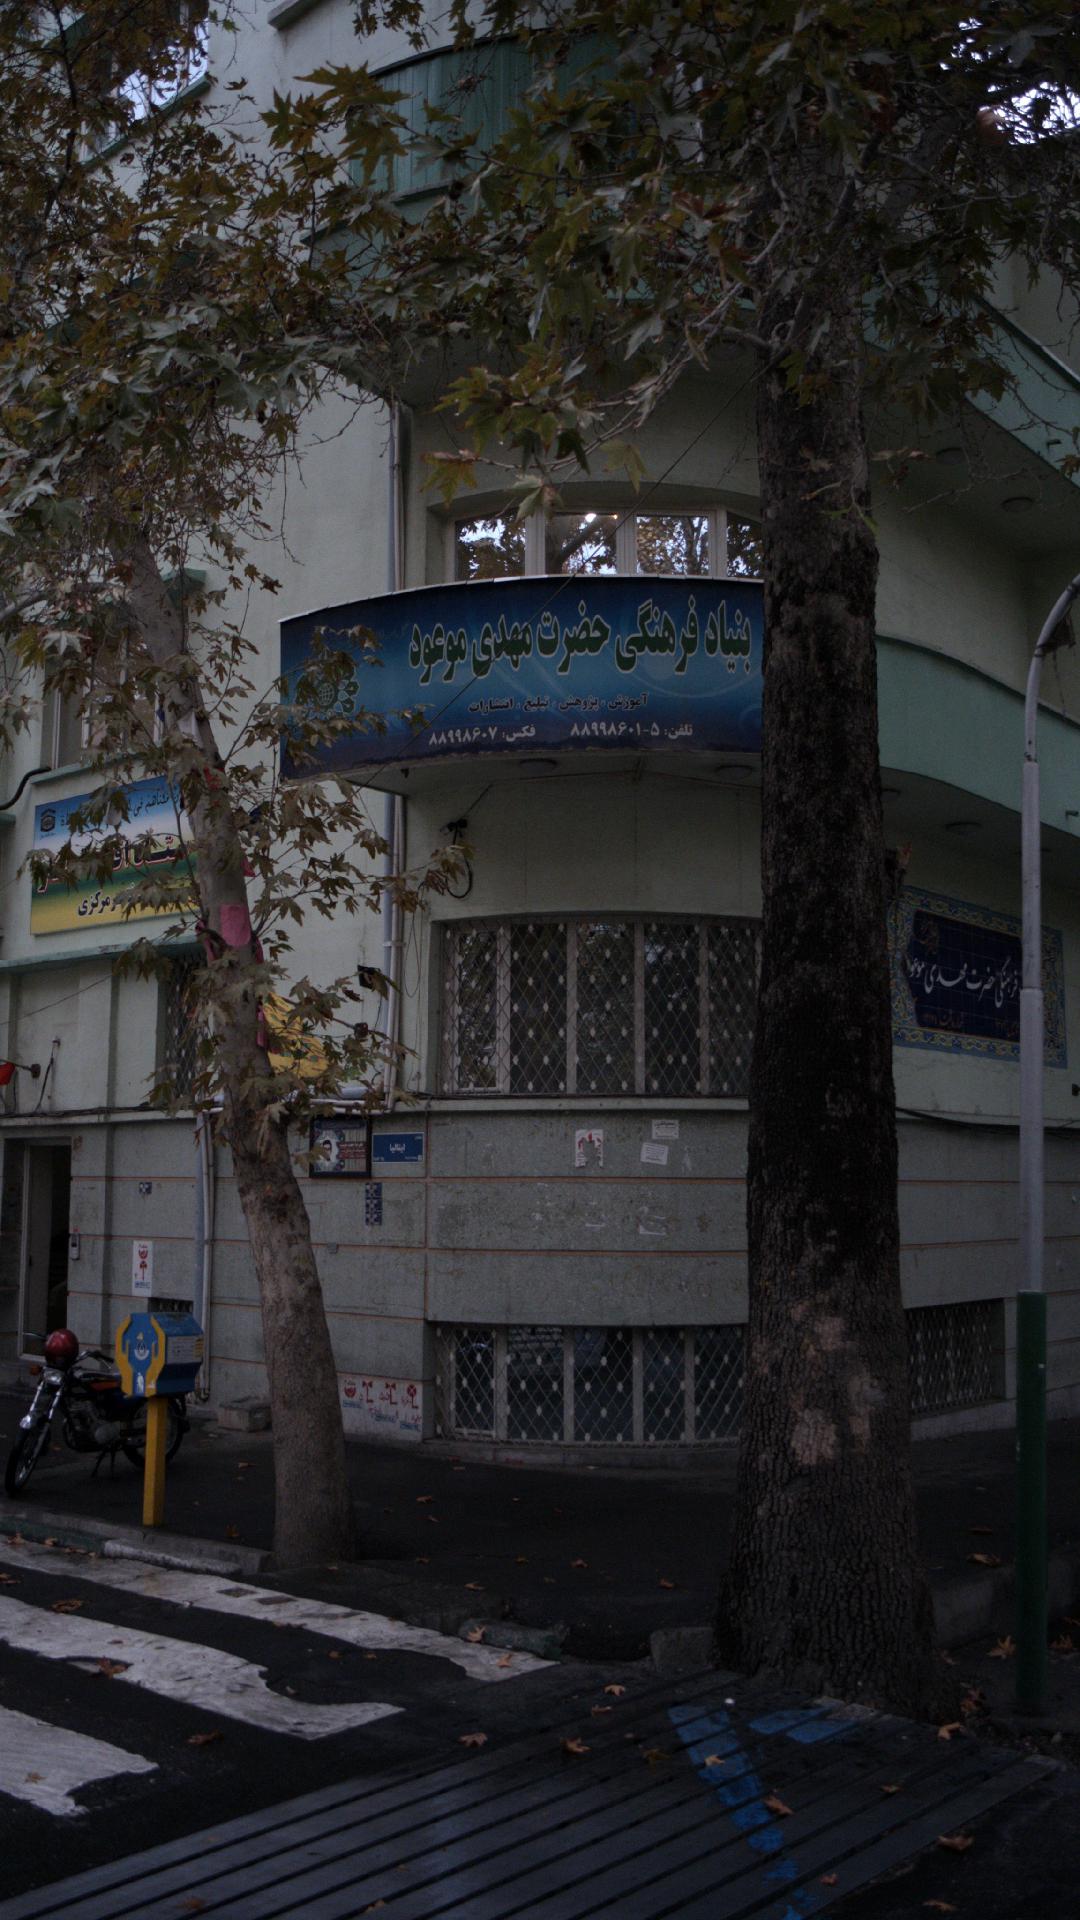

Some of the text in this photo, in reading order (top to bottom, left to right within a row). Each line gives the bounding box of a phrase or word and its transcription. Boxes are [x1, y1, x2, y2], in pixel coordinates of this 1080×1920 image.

[409, 594, 751, 686] بنیاد فرهنگی حضرت مهدی موعود
[468, 697, 514, 715] انتشارات
[608, 691, 649, 711] آموزش
[77, 890, 111, 916] مرکزی
